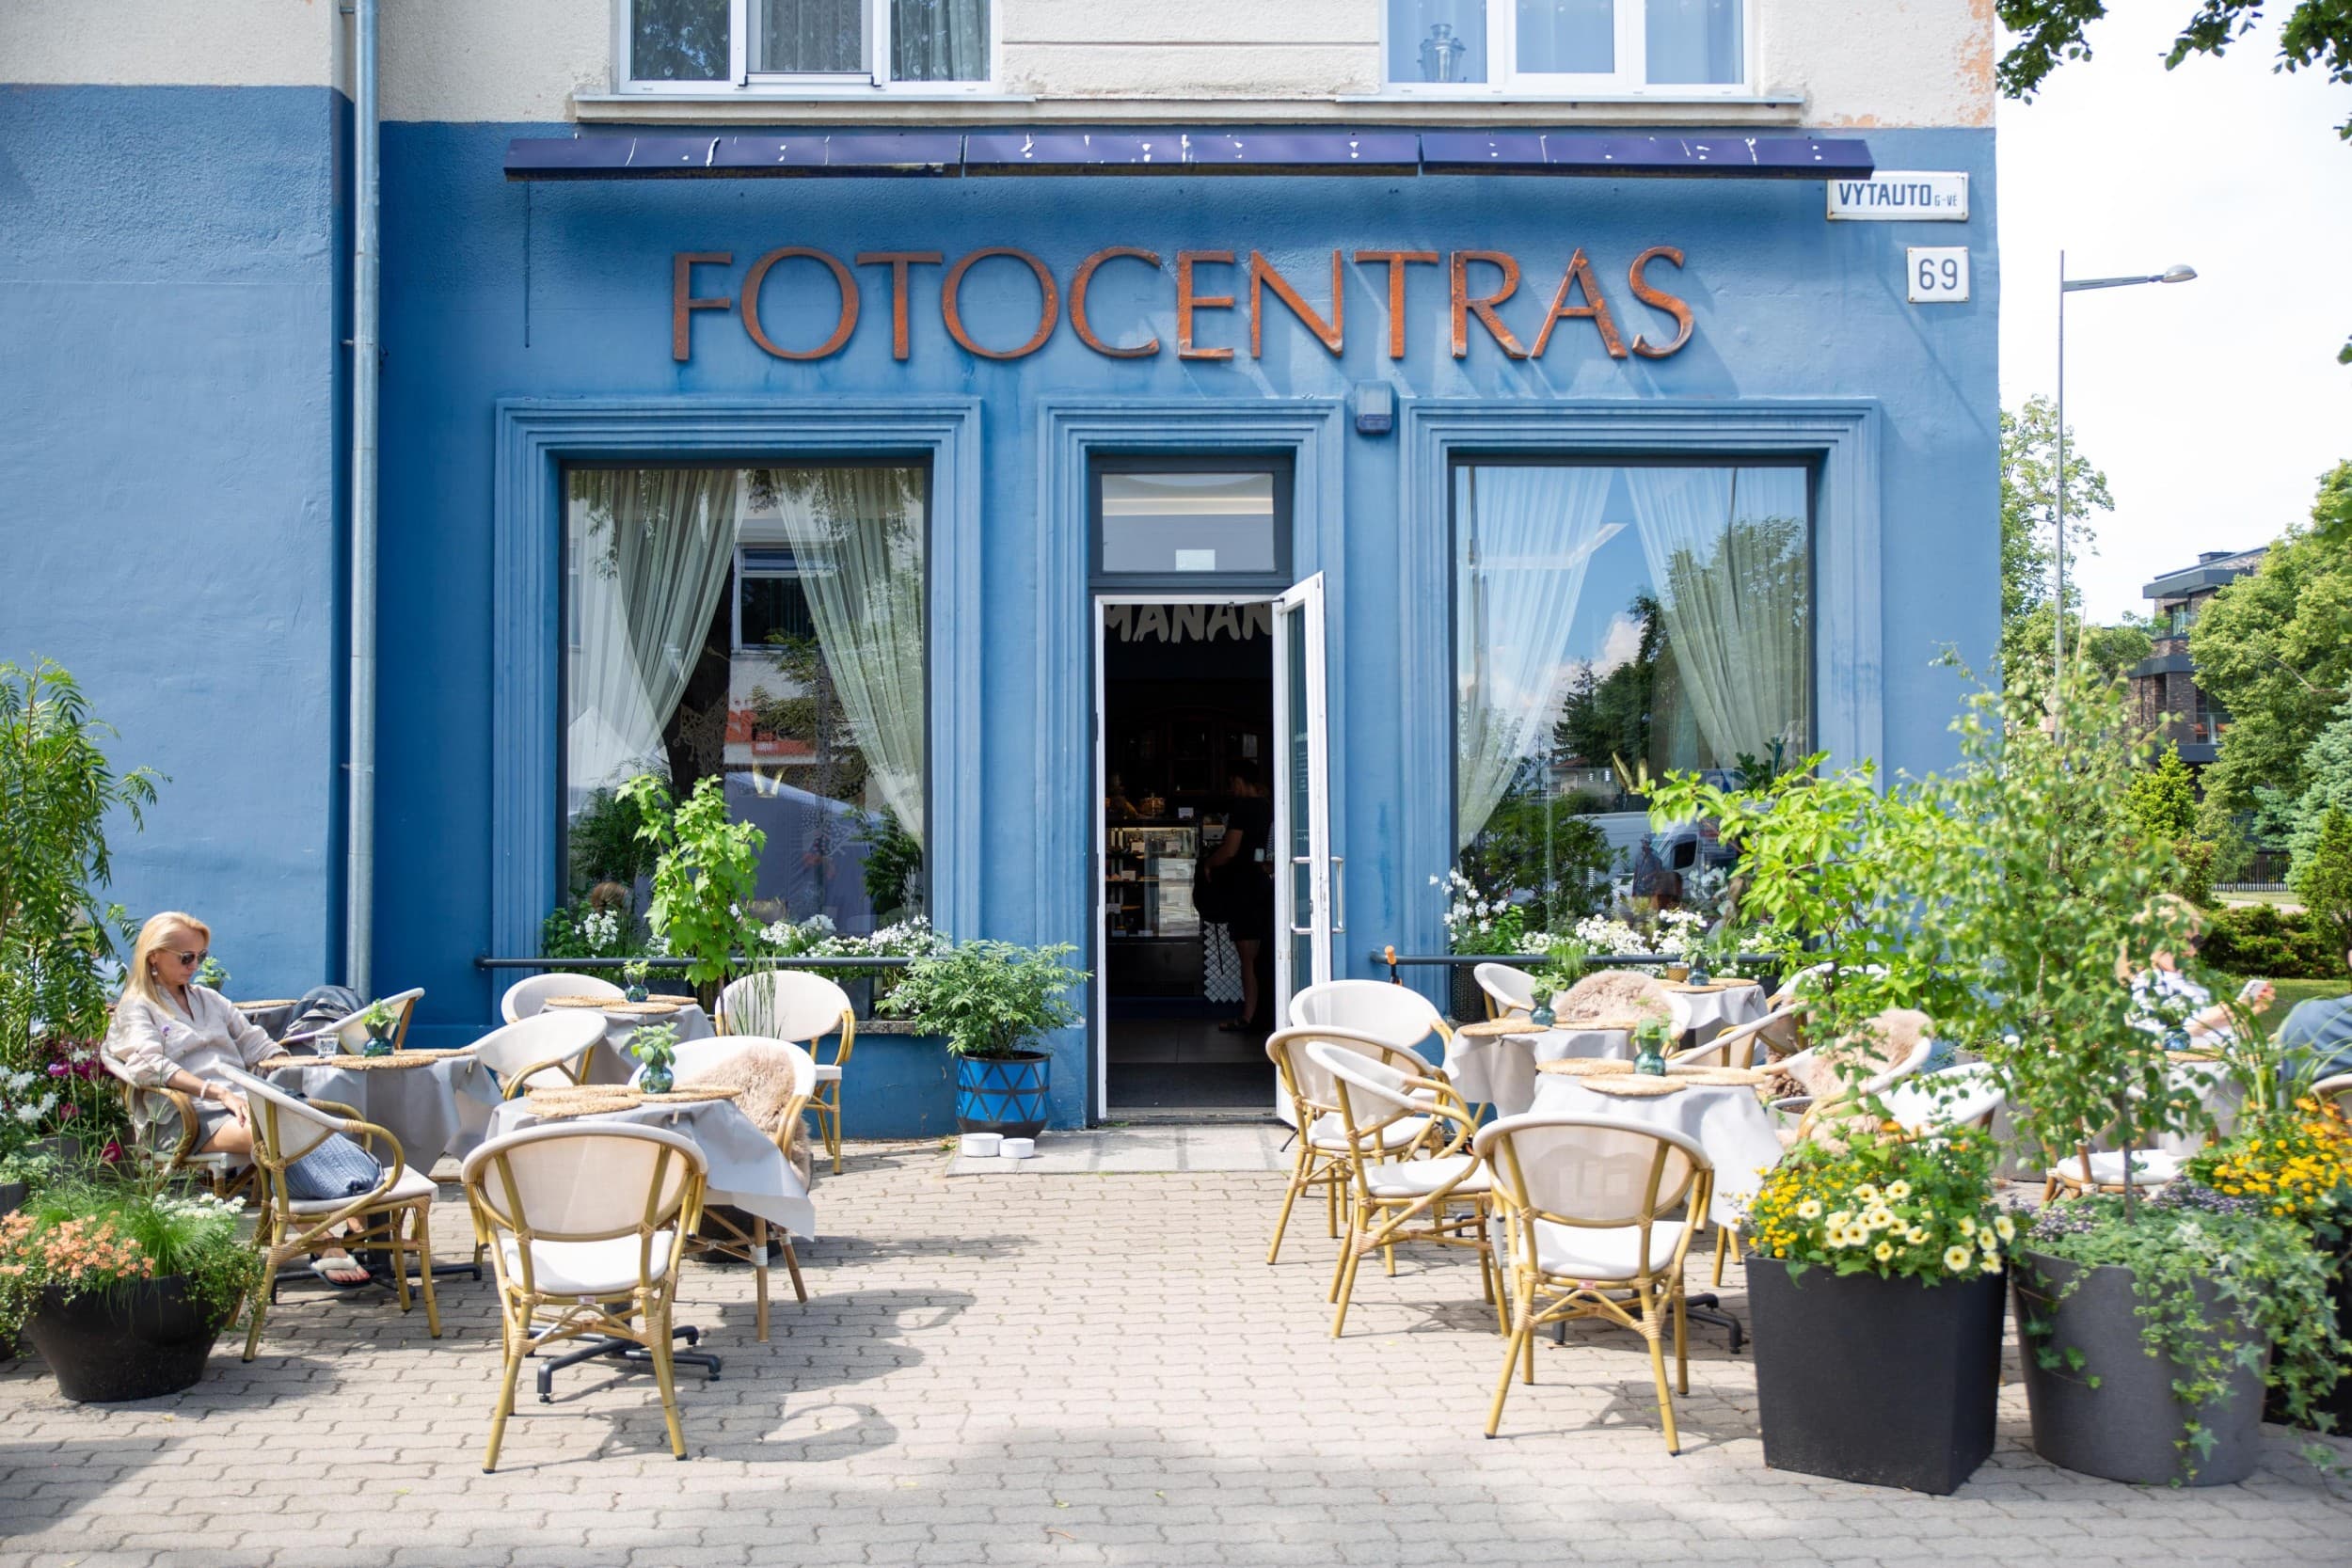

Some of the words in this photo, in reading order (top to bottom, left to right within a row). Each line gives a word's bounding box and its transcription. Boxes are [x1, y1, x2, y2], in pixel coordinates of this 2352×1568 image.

[1838, 182, 1931, 206] VYTAUTO
[1918, 258, 1958, 291] 69
[674, 246, 1693, 360] FOTOCENTRAS
